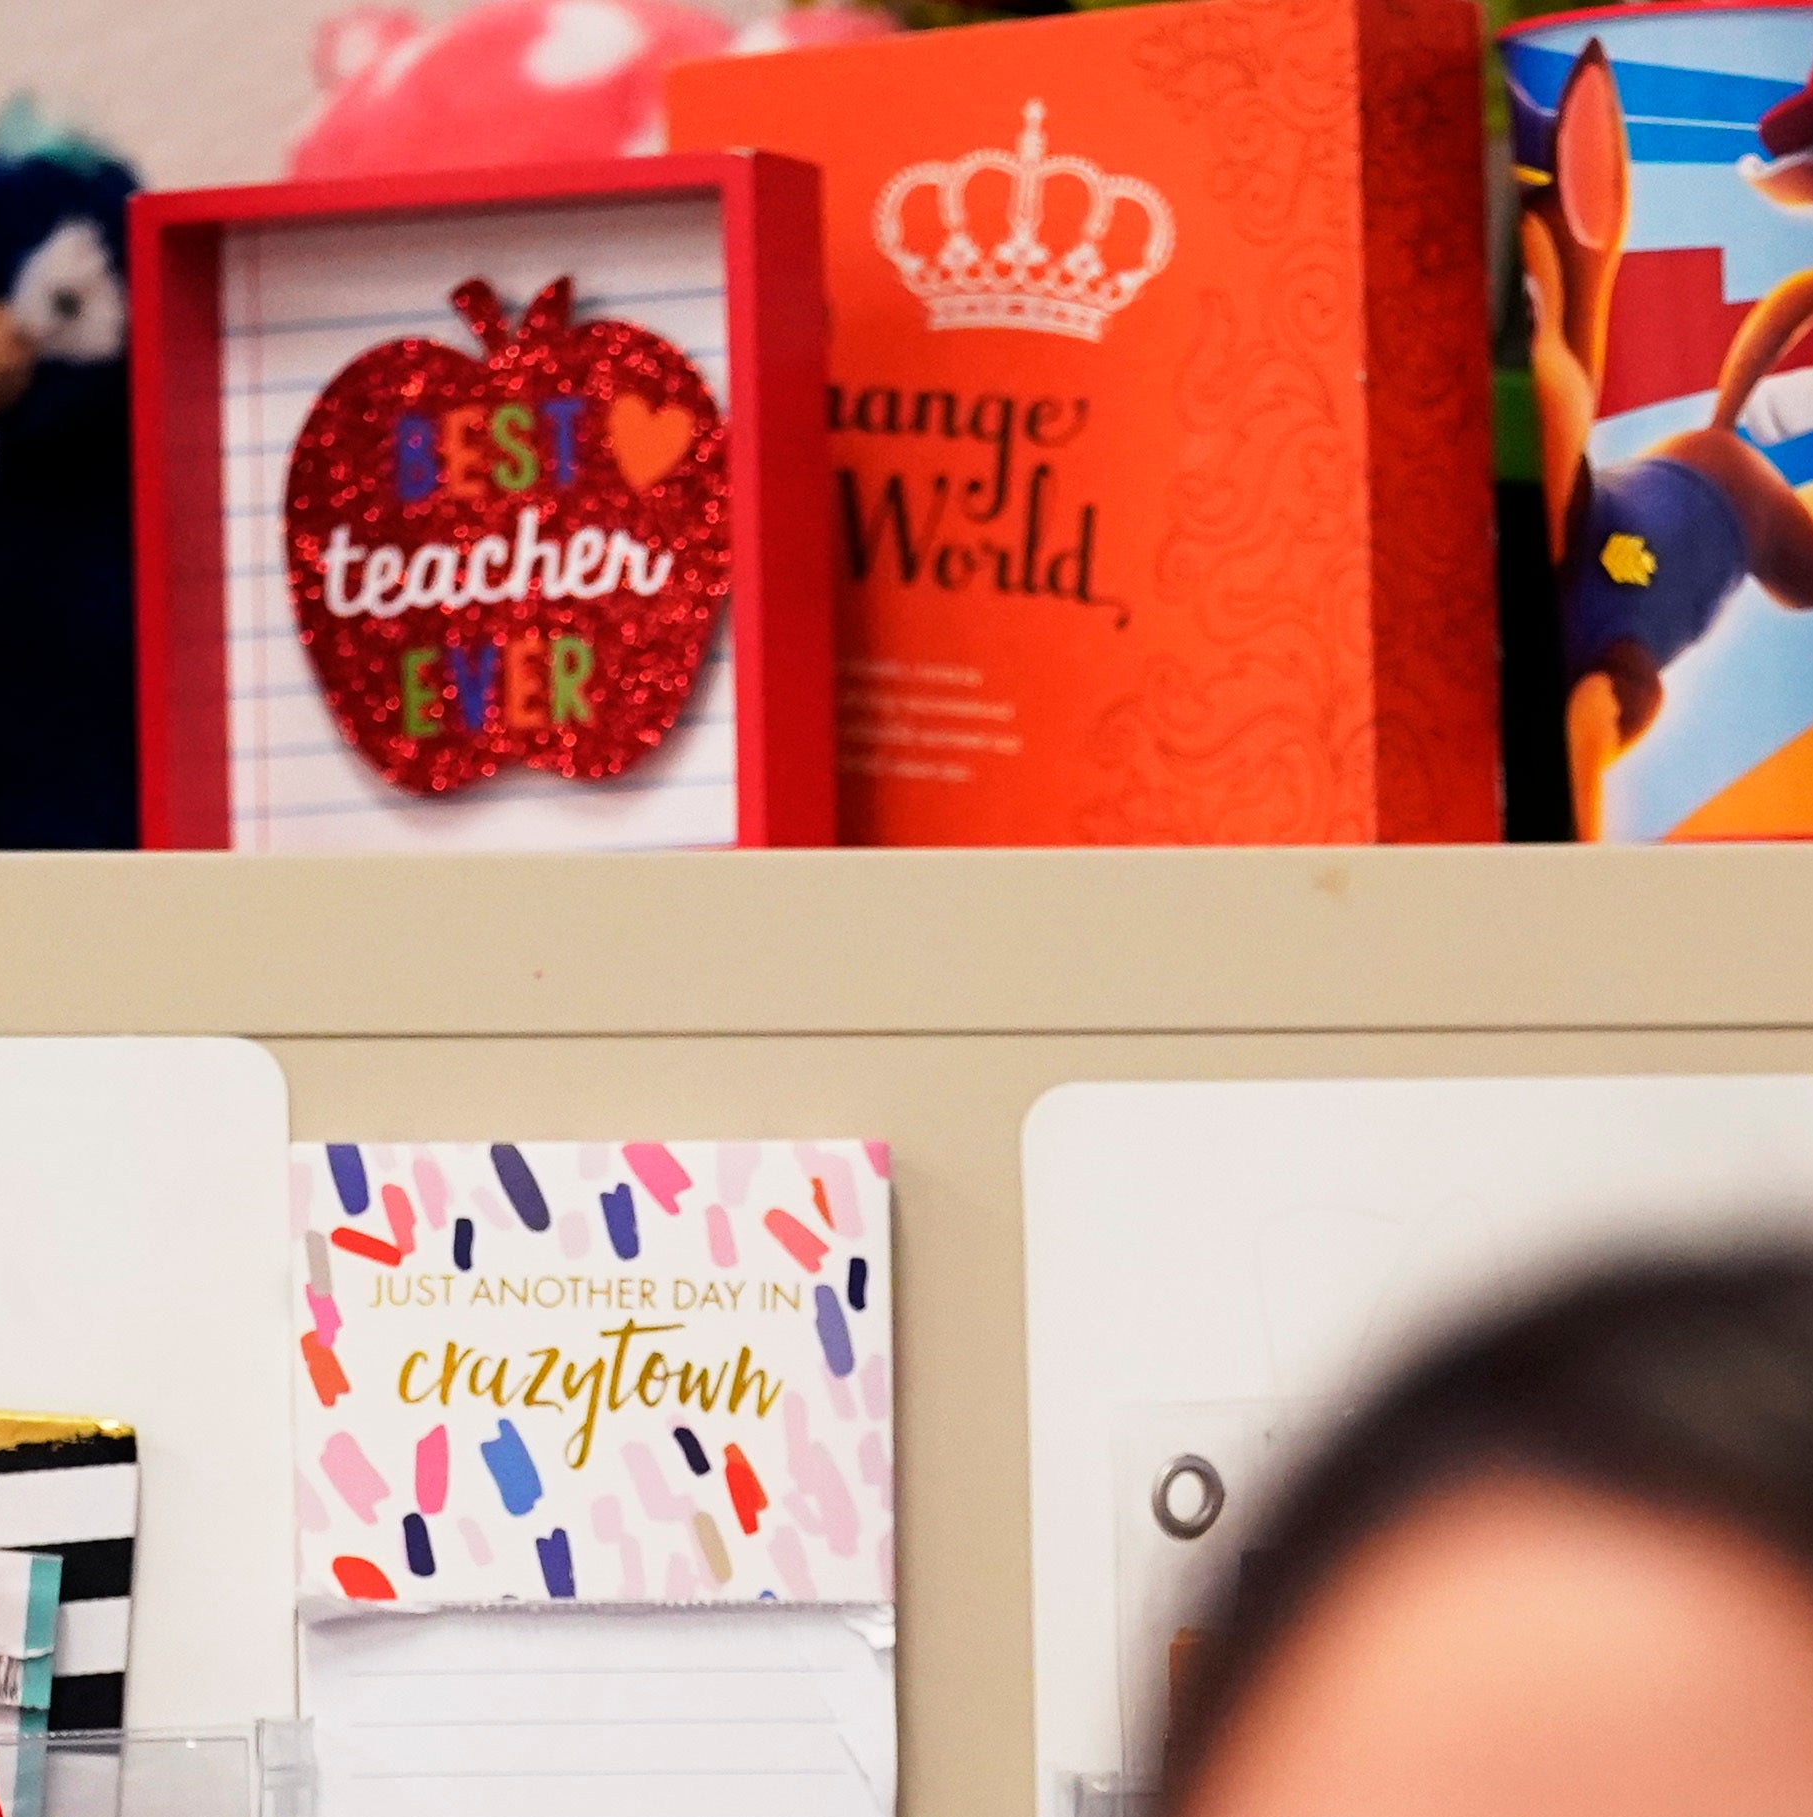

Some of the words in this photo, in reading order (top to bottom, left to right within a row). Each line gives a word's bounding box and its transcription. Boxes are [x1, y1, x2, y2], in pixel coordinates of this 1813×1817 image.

[395, 398, 586, 502] BEST
[318, 506, 674, 619] teacher
[837, 463, 1130, 631] World
[400, 635, 594, 738] EVER
[369, 1274, 455, 1309] JUST
[468, 1275, 658, 1311] ANOTHER
[674, 1279, 746, 1311] DAY
[760, 1281, 801, 1312] IN
[397, 1318, 782, 1469] crazytown
